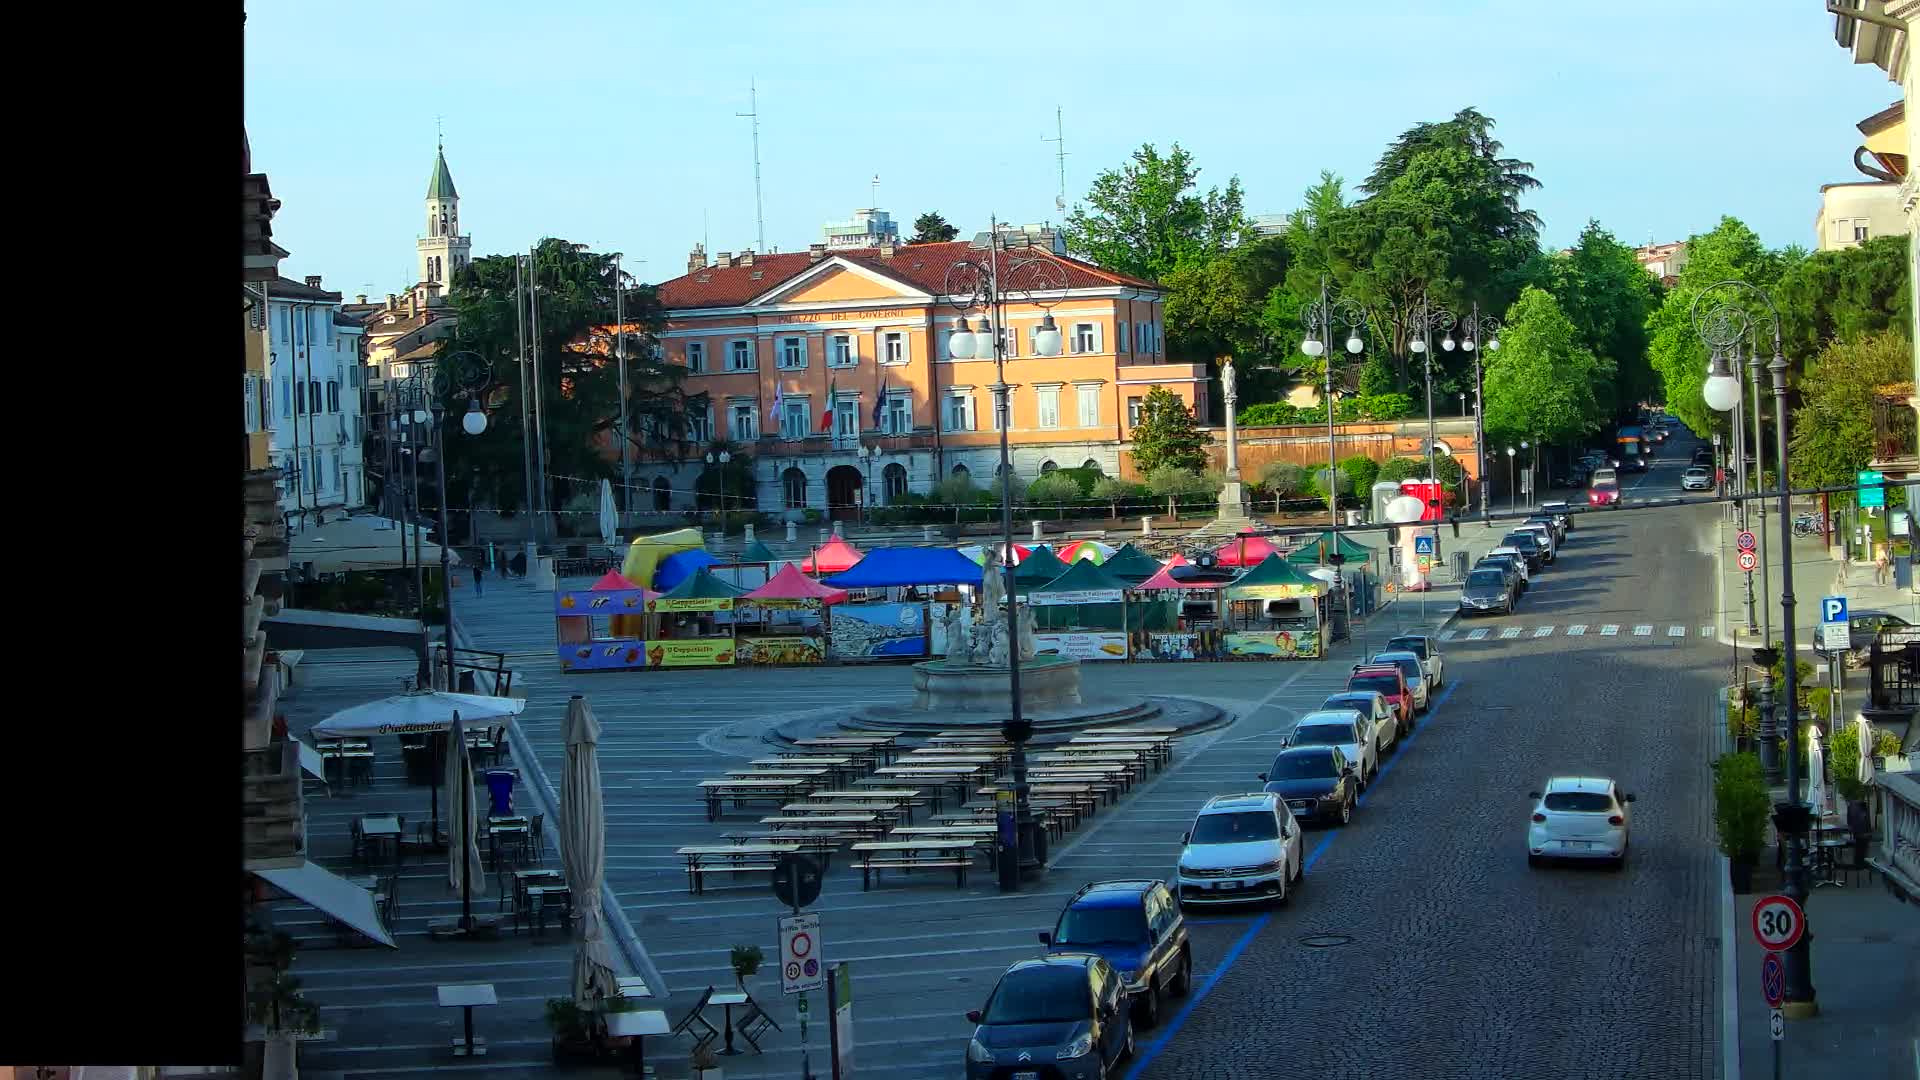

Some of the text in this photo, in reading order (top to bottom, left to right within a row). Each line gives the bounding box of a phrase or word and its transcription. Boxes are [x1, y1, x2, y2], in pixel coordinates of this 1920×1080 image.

[831, 312, 848, 321] DEL
[857, 309, 904, 320] GOVERNO
[1742, 556, 1752, 565] 20
[1827, 600, 1842, 621] P
[1762, 910, 1791, 936] 30
